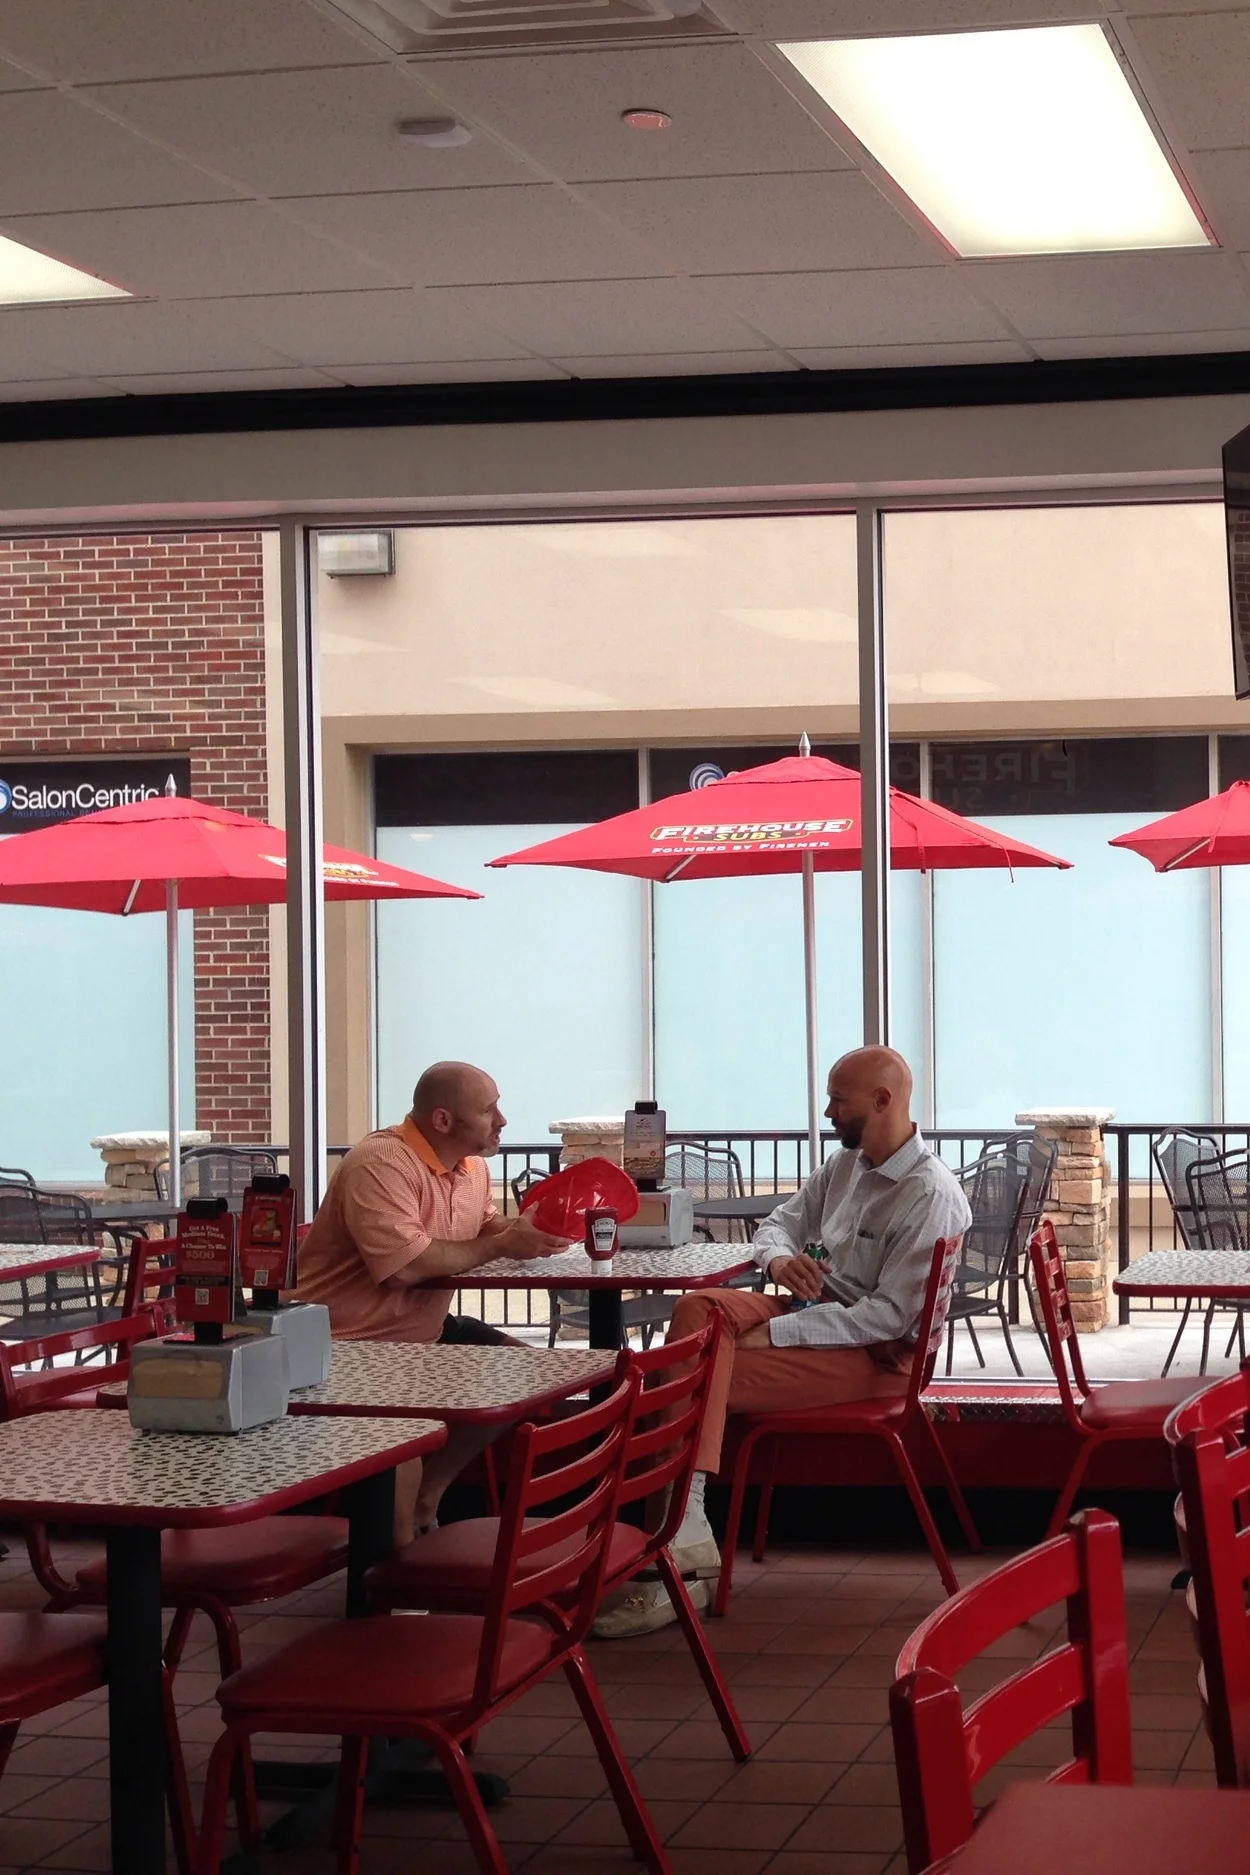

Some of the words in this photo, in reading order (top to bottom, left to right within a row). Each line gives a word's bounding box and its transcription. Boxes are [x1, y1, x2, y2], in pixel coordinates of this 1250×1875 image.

[11, 783, 159, 810] SalonCentric
[656, 820, 847, 841] FIREHOUSE
[713, 831, 782, 841] SUBS
[651, 846, 727, 854] FOUNDED
[758, 841, 830, 850] FIREMEN
